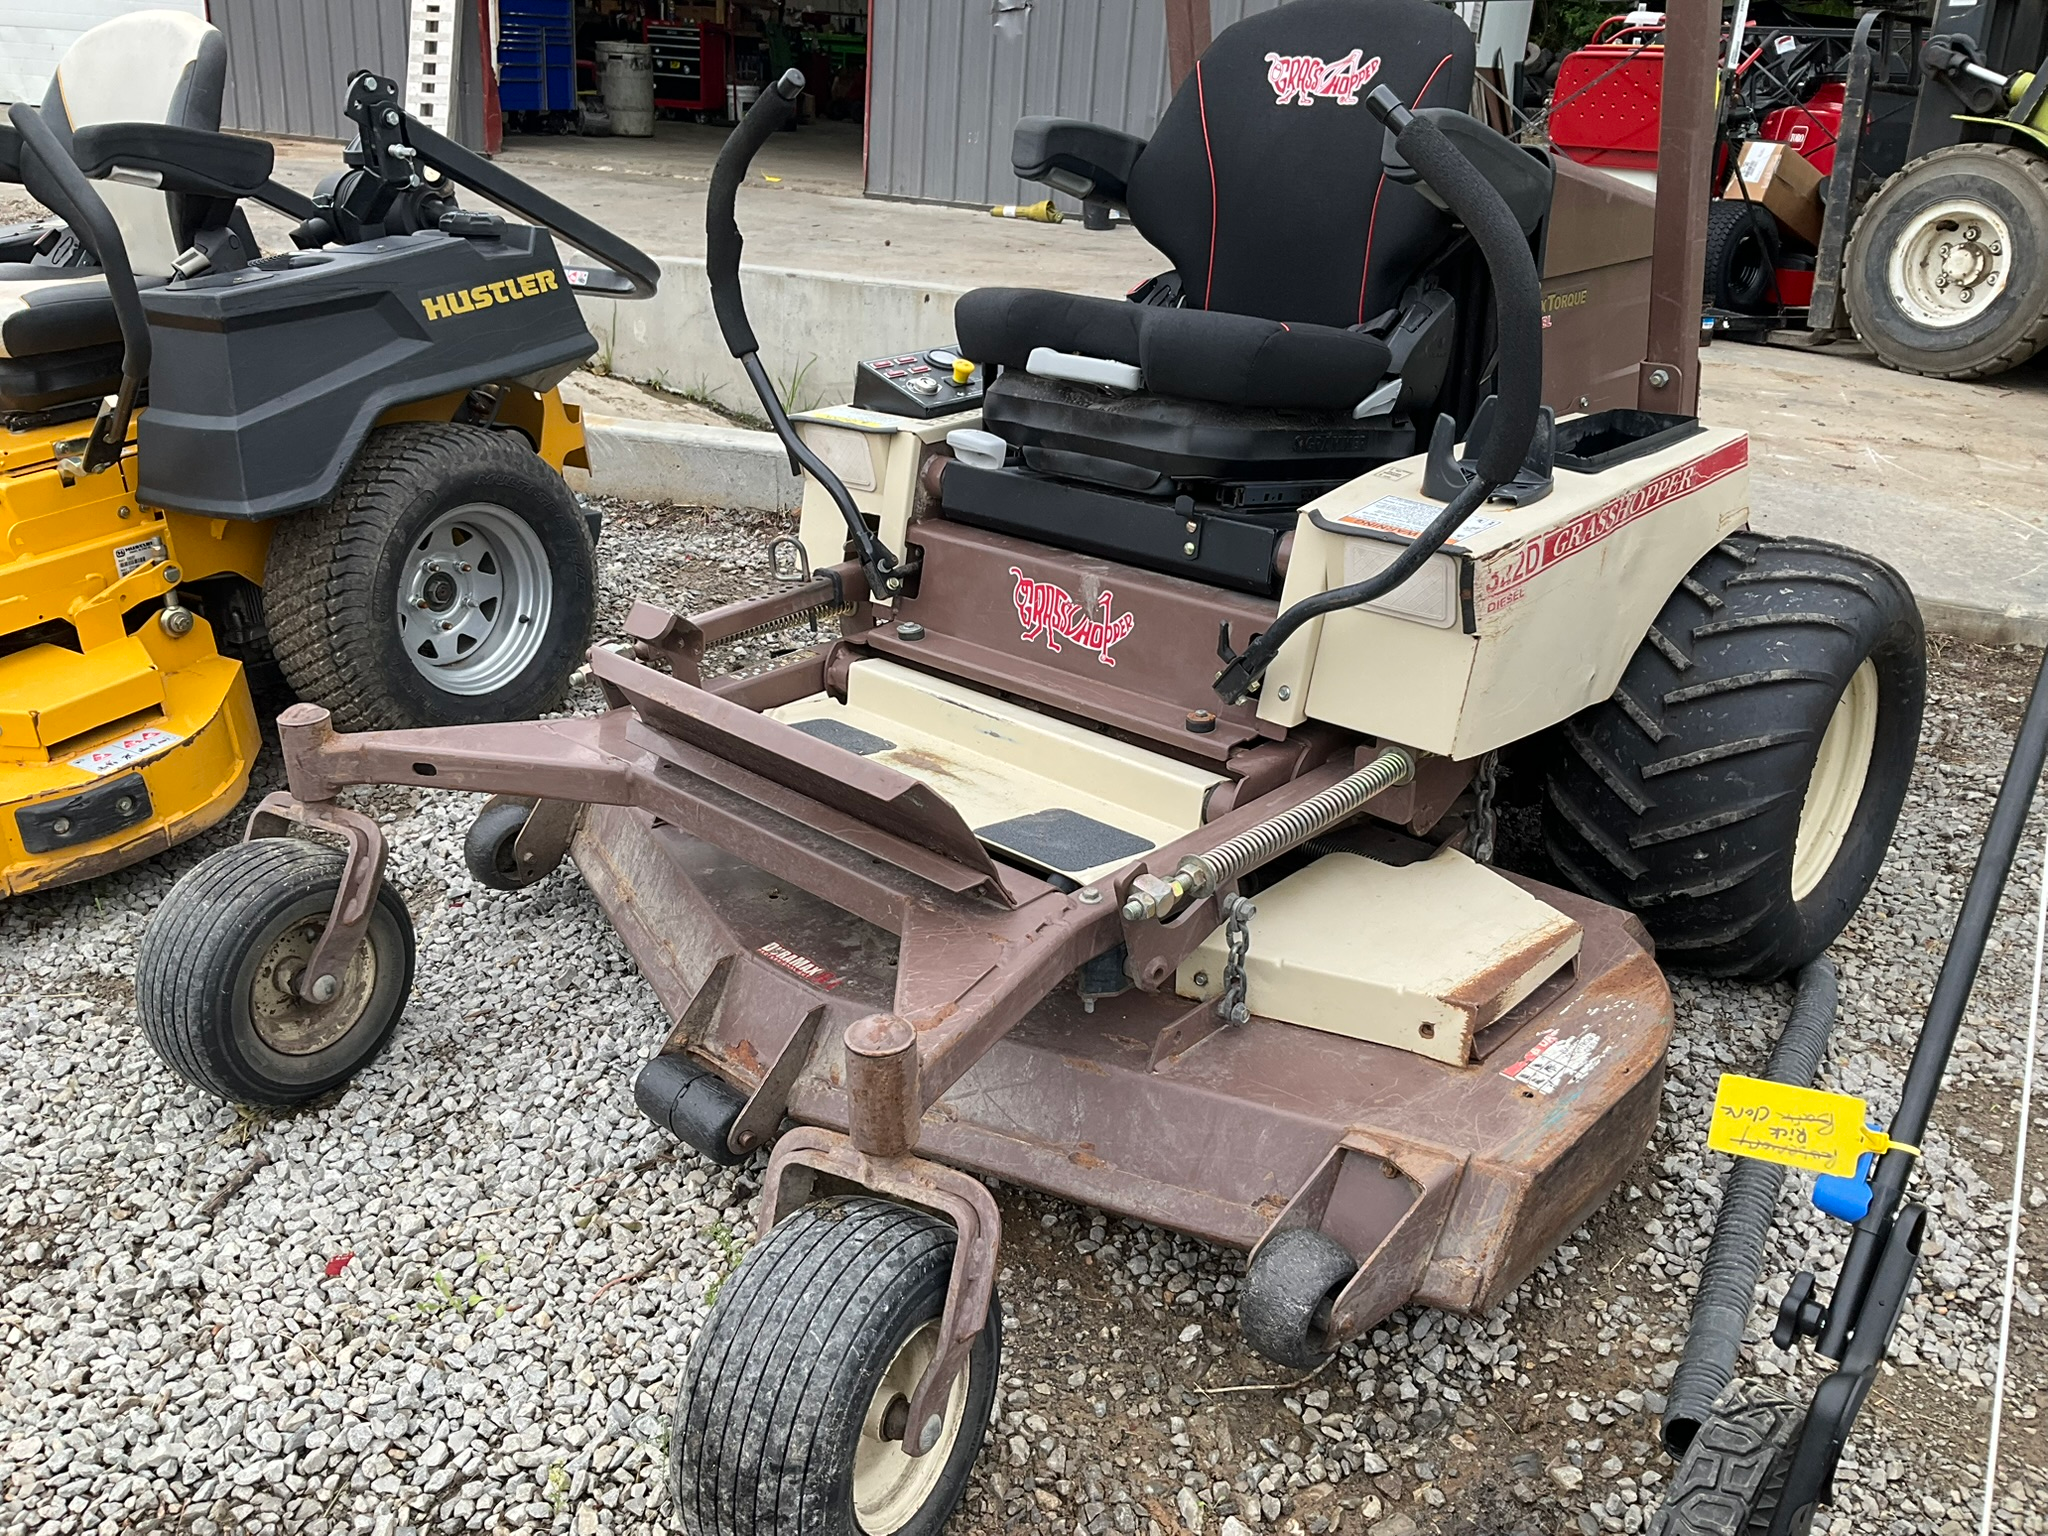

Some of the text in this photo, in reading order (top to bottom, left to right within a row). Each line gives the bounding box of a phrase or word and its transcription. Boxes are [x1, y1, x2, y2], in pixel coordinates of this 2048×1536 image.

[421, 269, 559, 321] HUSTLER
[1541, 290, 1587, 312] XTORQUE
[1553, 465, 1695, 557] GRASSHOPPER
[1487, 589, 1525, 613] DIESEL
[1769, 1127, 1807, 1143] Rick
